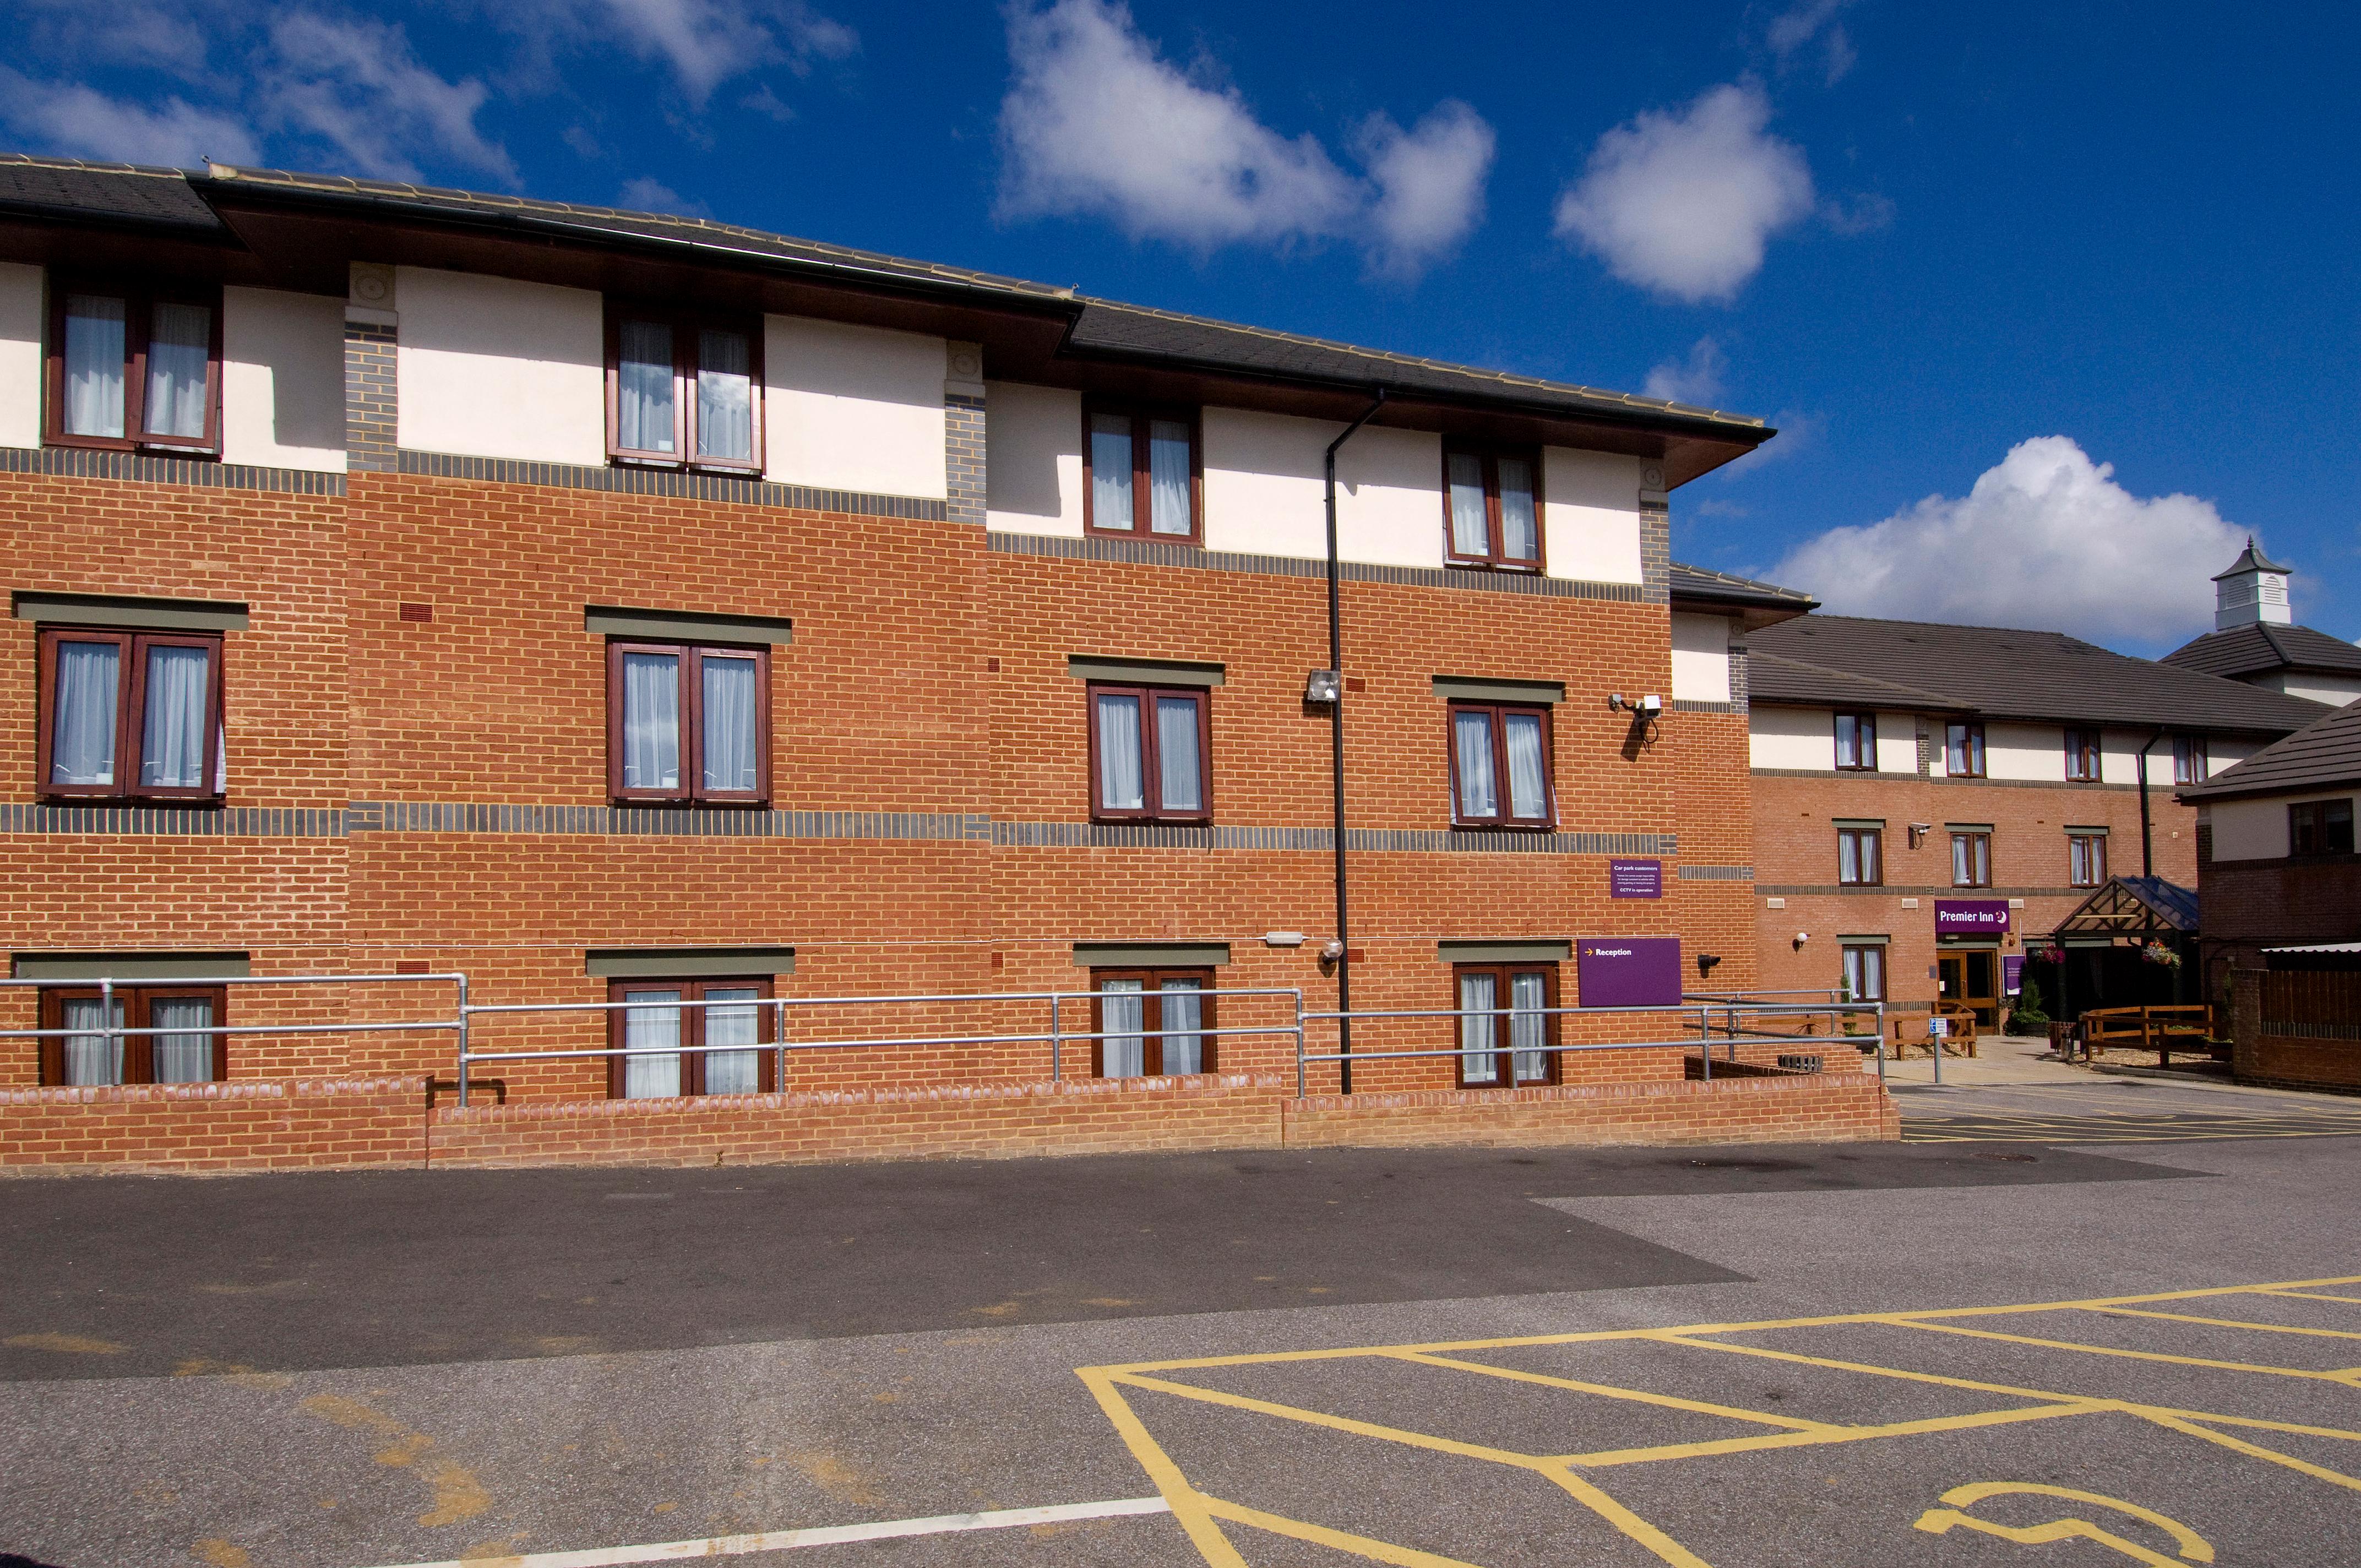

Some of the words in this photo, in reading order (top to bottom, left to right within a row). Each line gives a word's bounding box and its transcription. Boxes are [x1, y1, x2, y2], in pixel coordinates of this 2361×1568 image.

[1940, 911, 1977, 922] Premier
[1979, 911, 1994, 922] Inn
[1595, 948, 1631, 957] Reception
